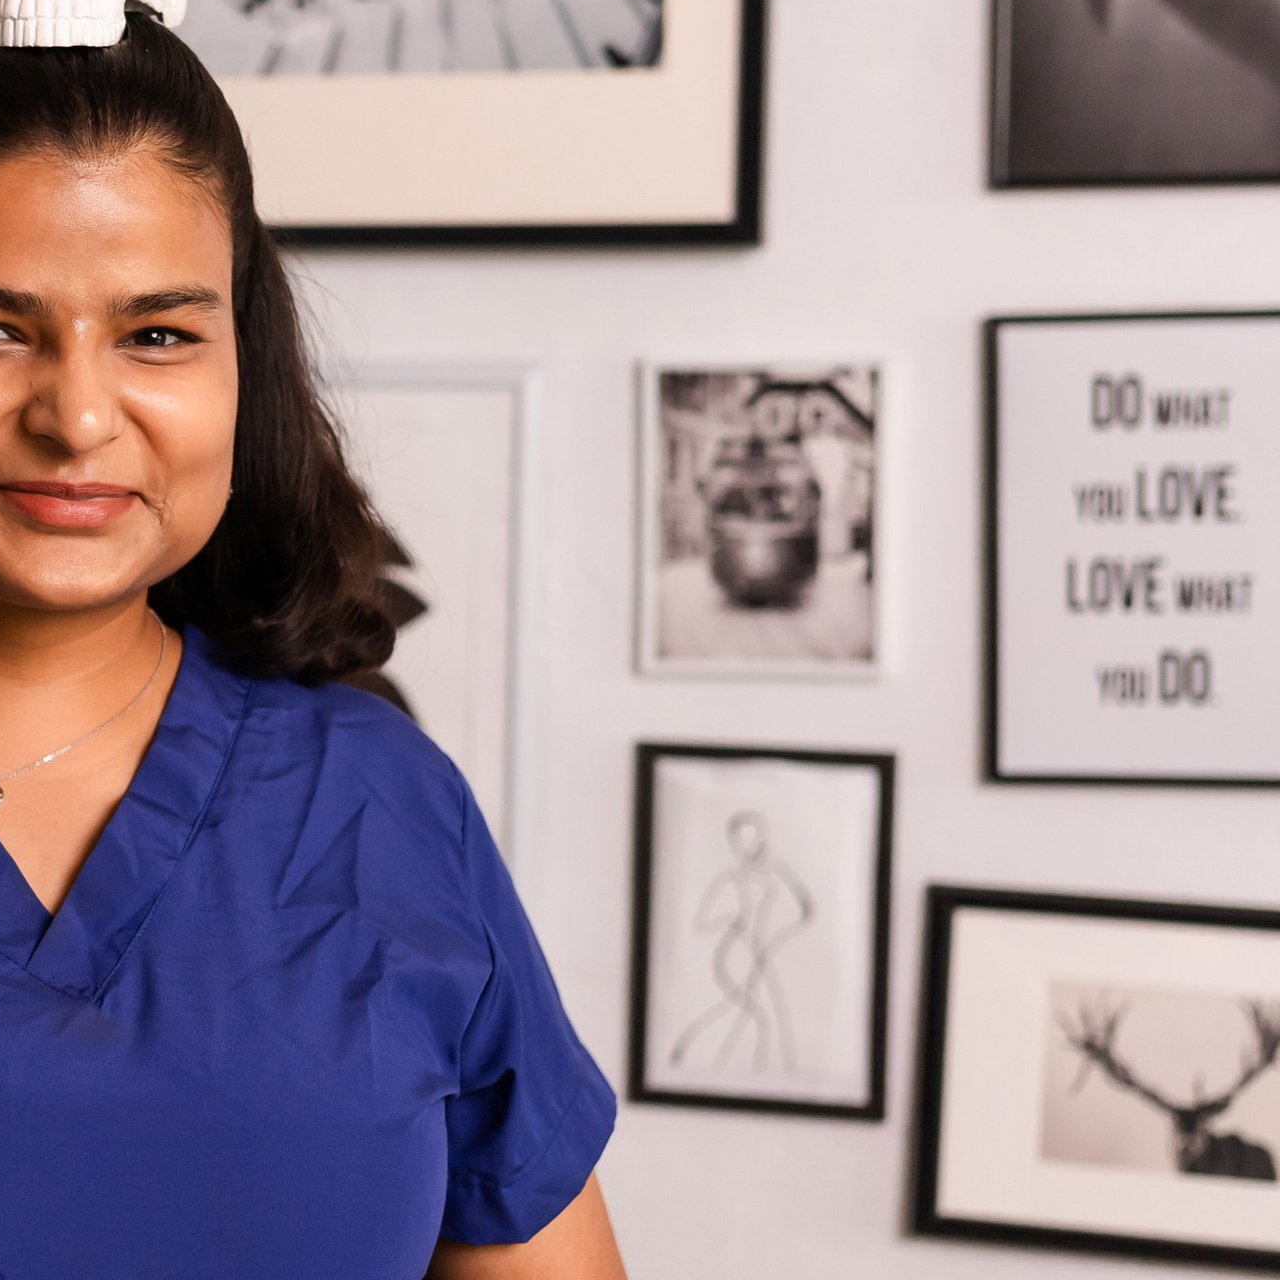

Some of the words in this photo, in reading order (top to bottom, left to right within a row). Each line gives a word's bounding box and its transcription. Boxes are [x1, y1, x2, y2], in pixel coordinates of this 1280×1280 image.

[1090, 373, 1143, 430] DO
[1150, 389, 1230, 427] WHAT
[1074, 483, 1127, 522] YOU
[1066, 556, 1164, 615] LOVE
[1173, 574, 1253, 614] WHAT
[1097, 664, 1149, 705] YOU
